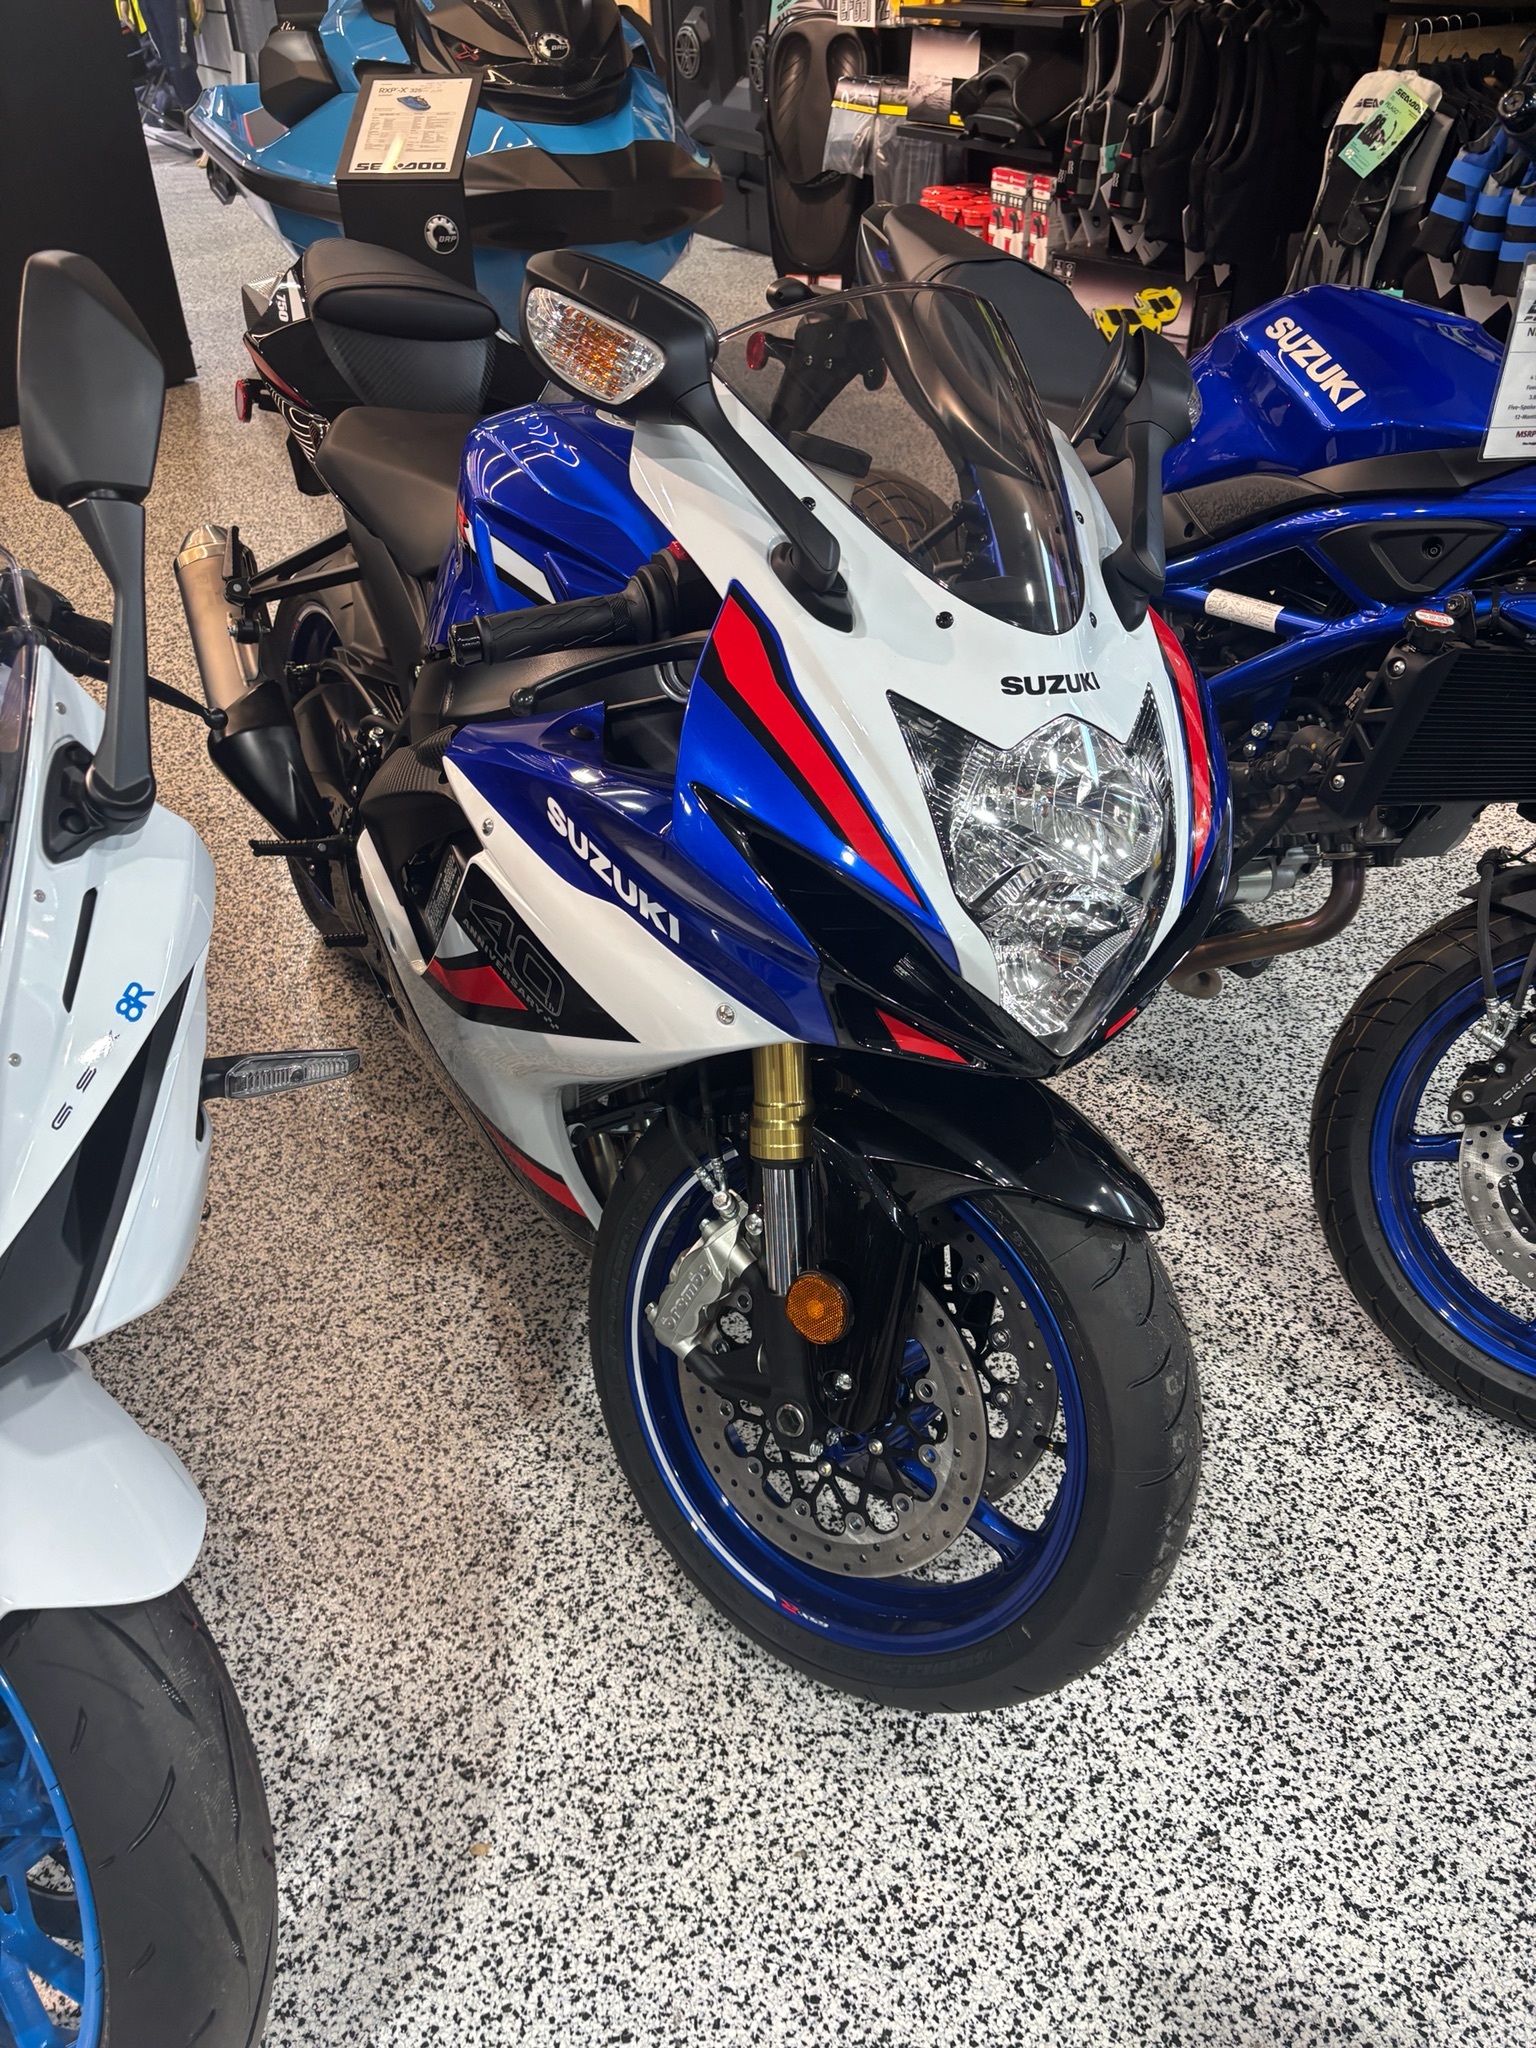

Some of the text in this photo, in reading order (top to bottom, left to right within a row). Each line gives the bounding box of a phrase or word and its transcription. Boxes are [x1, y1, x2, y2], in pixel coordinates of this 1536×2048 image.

[438, 234, 457, 244] BRP
[276, 293, 290, 323] 750
[1265, 317, 1367, 413] SUZUKI
[1000, 671, 1101, 696] SUZUKI
[546, 796, 680, 945] SUZUKI
[461, 917, 544, 1016] ANNIVERSARY
[658, 1261, 713, 1331] brembo
